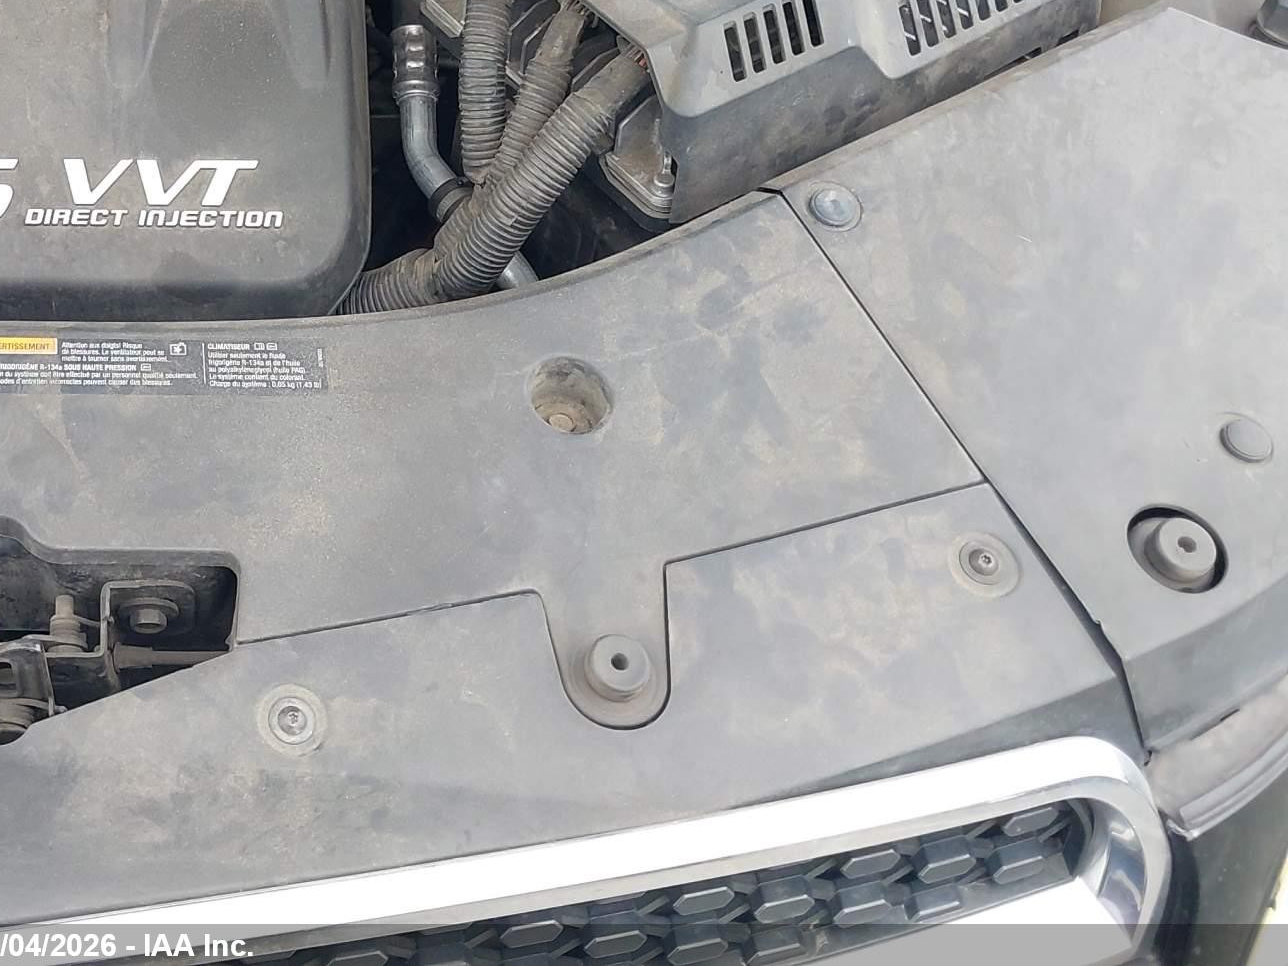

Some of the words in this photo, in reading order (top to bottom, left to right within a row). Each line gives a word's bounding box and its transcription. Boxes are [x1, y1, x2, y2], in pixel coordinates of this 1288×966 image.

[62, 158, 259, 206] VVT
[25, 208, 128, 227] DIRECT
[139, 210, 283, 228] INJECTION
